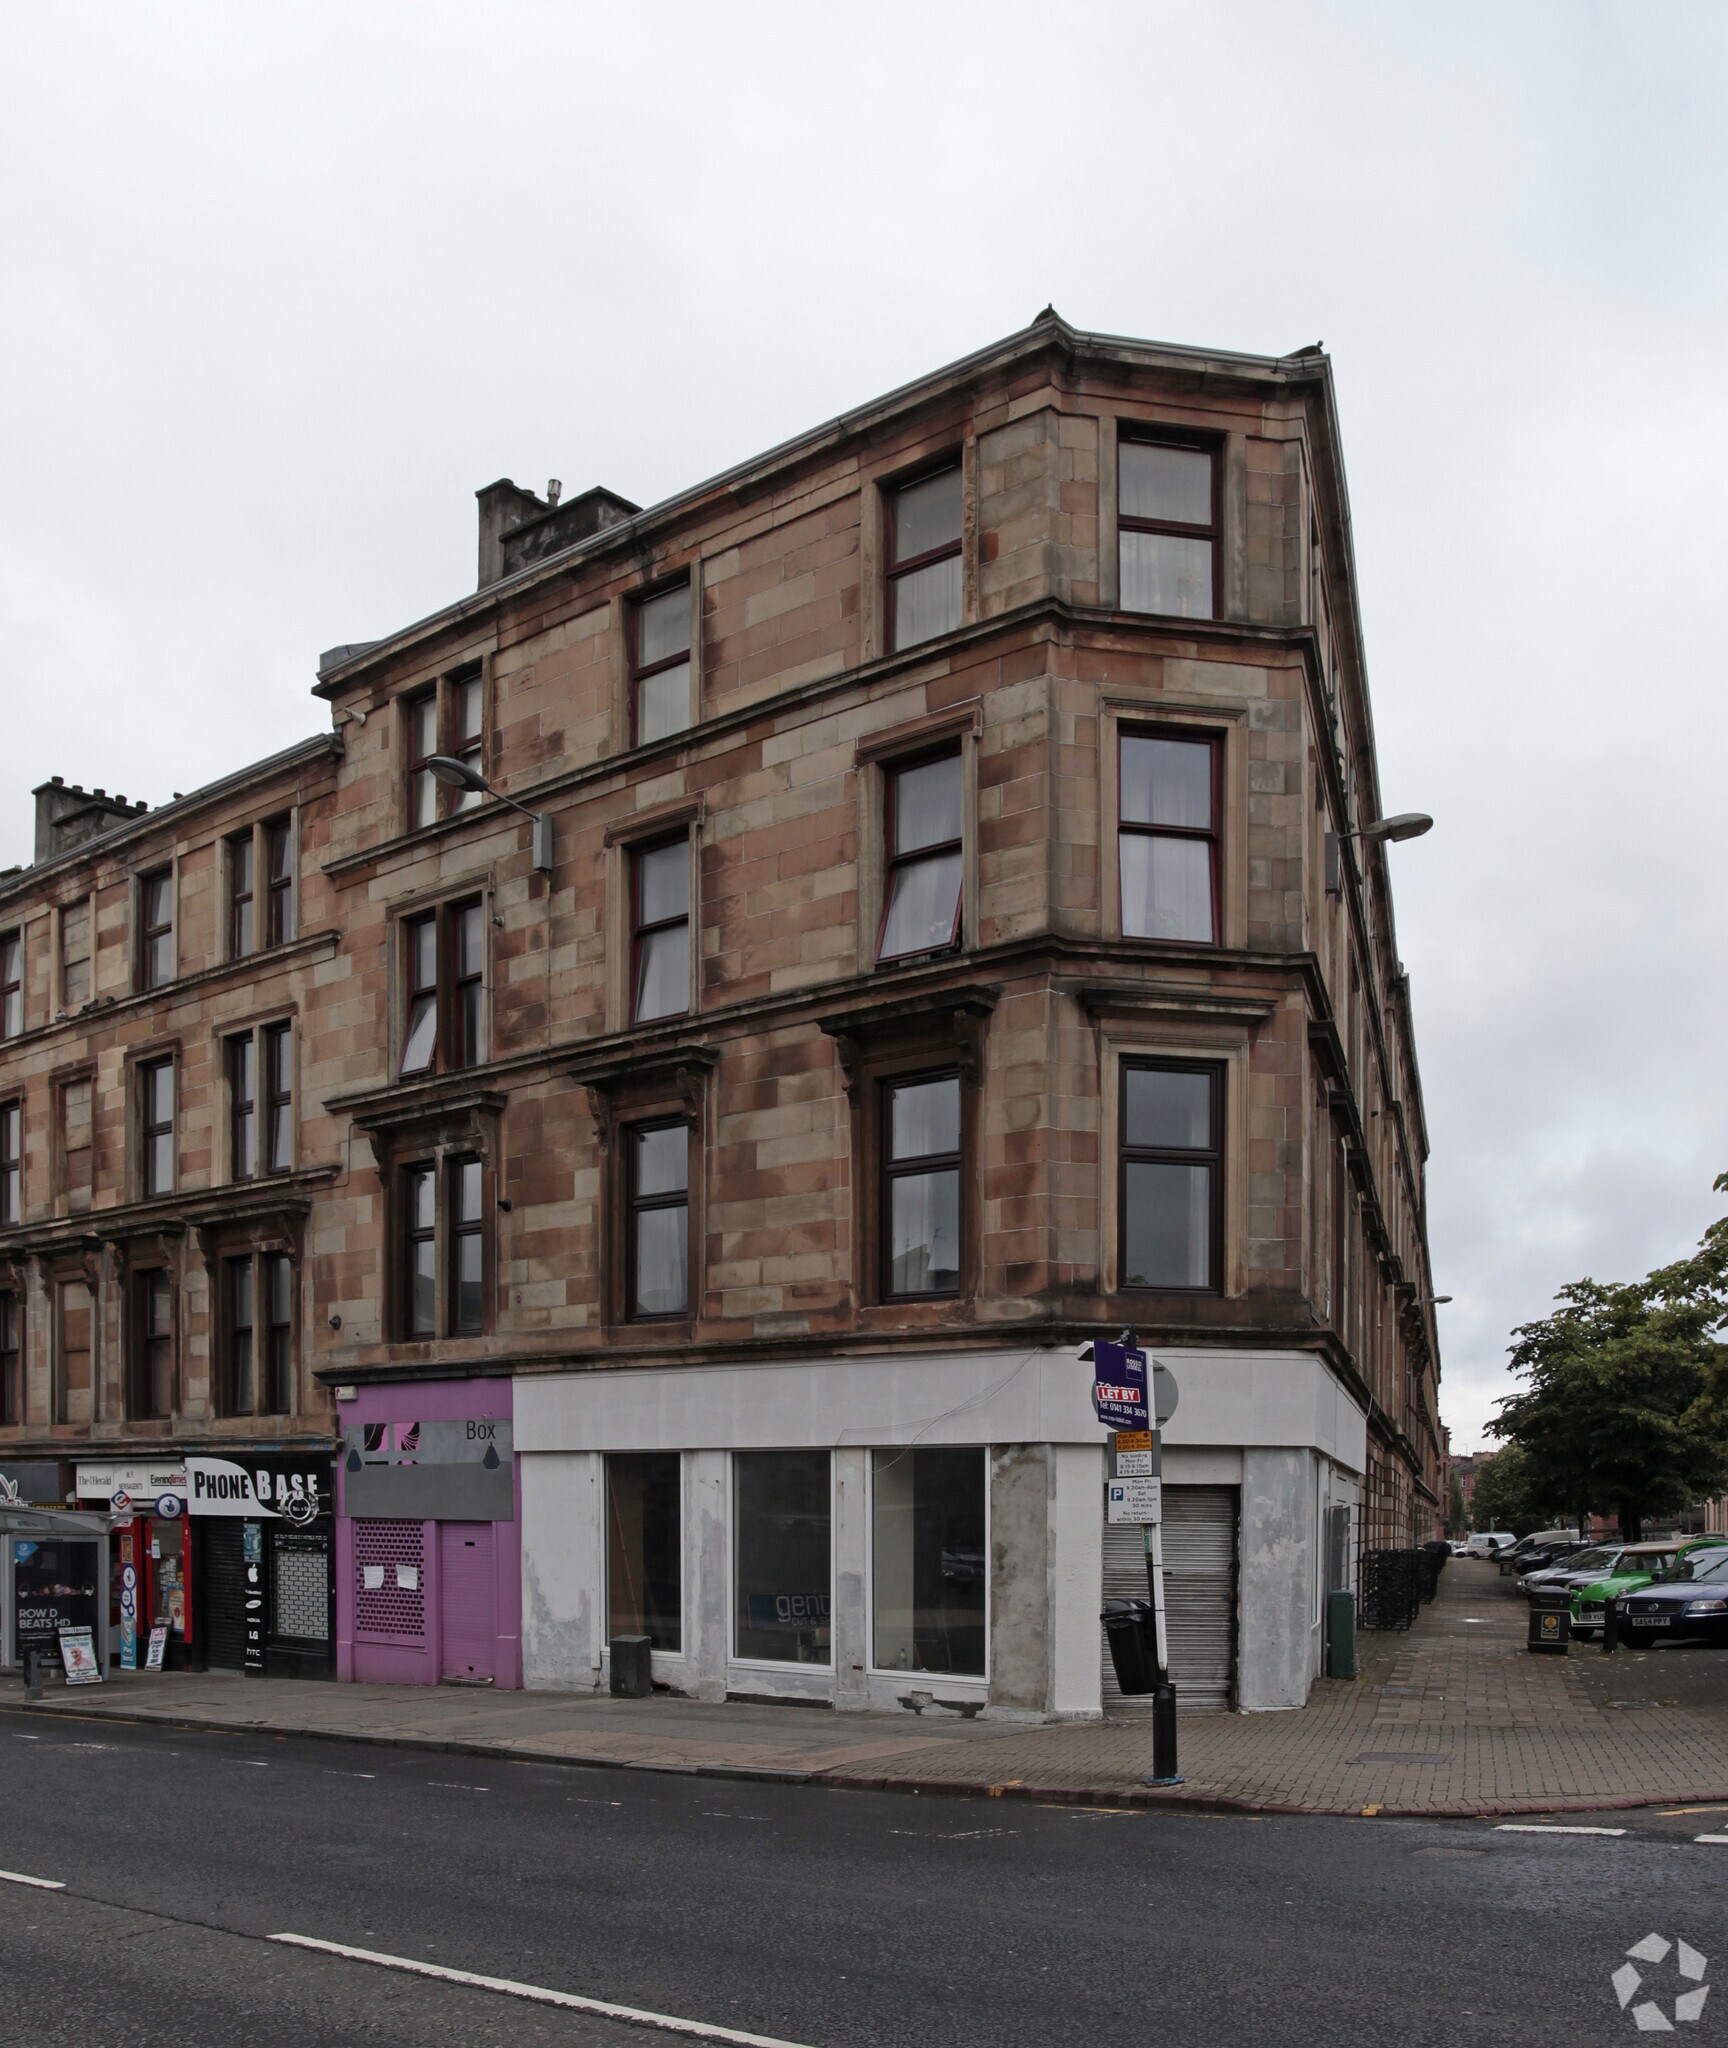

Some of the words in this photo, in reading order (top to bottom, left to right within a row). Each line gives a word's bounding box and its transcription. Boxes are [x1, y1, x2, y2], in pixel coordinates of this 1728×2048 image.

[1101, 1389, 1119, 1399] LET
[1122, 1390, 1135, 1400] BY
[1110, 1402, 1122, 1413] 0141
[1123, 1405, 1133, 1415] 334
[1134, 1407, 1147, 1418] 3670
[466, 1420, 496, 1440] Box
[194, 1471, 250, 1499] PHONE
[1113, 1488, 1122, 1500] P
[19, 1608, 47, 1618] ROW
[49, 1608, 58, 1618] D
[19, 1619, 52, 1629] BEATS
[54, 1618, 71, 1627] HD
[248, 1630, 259, 1640] LG
